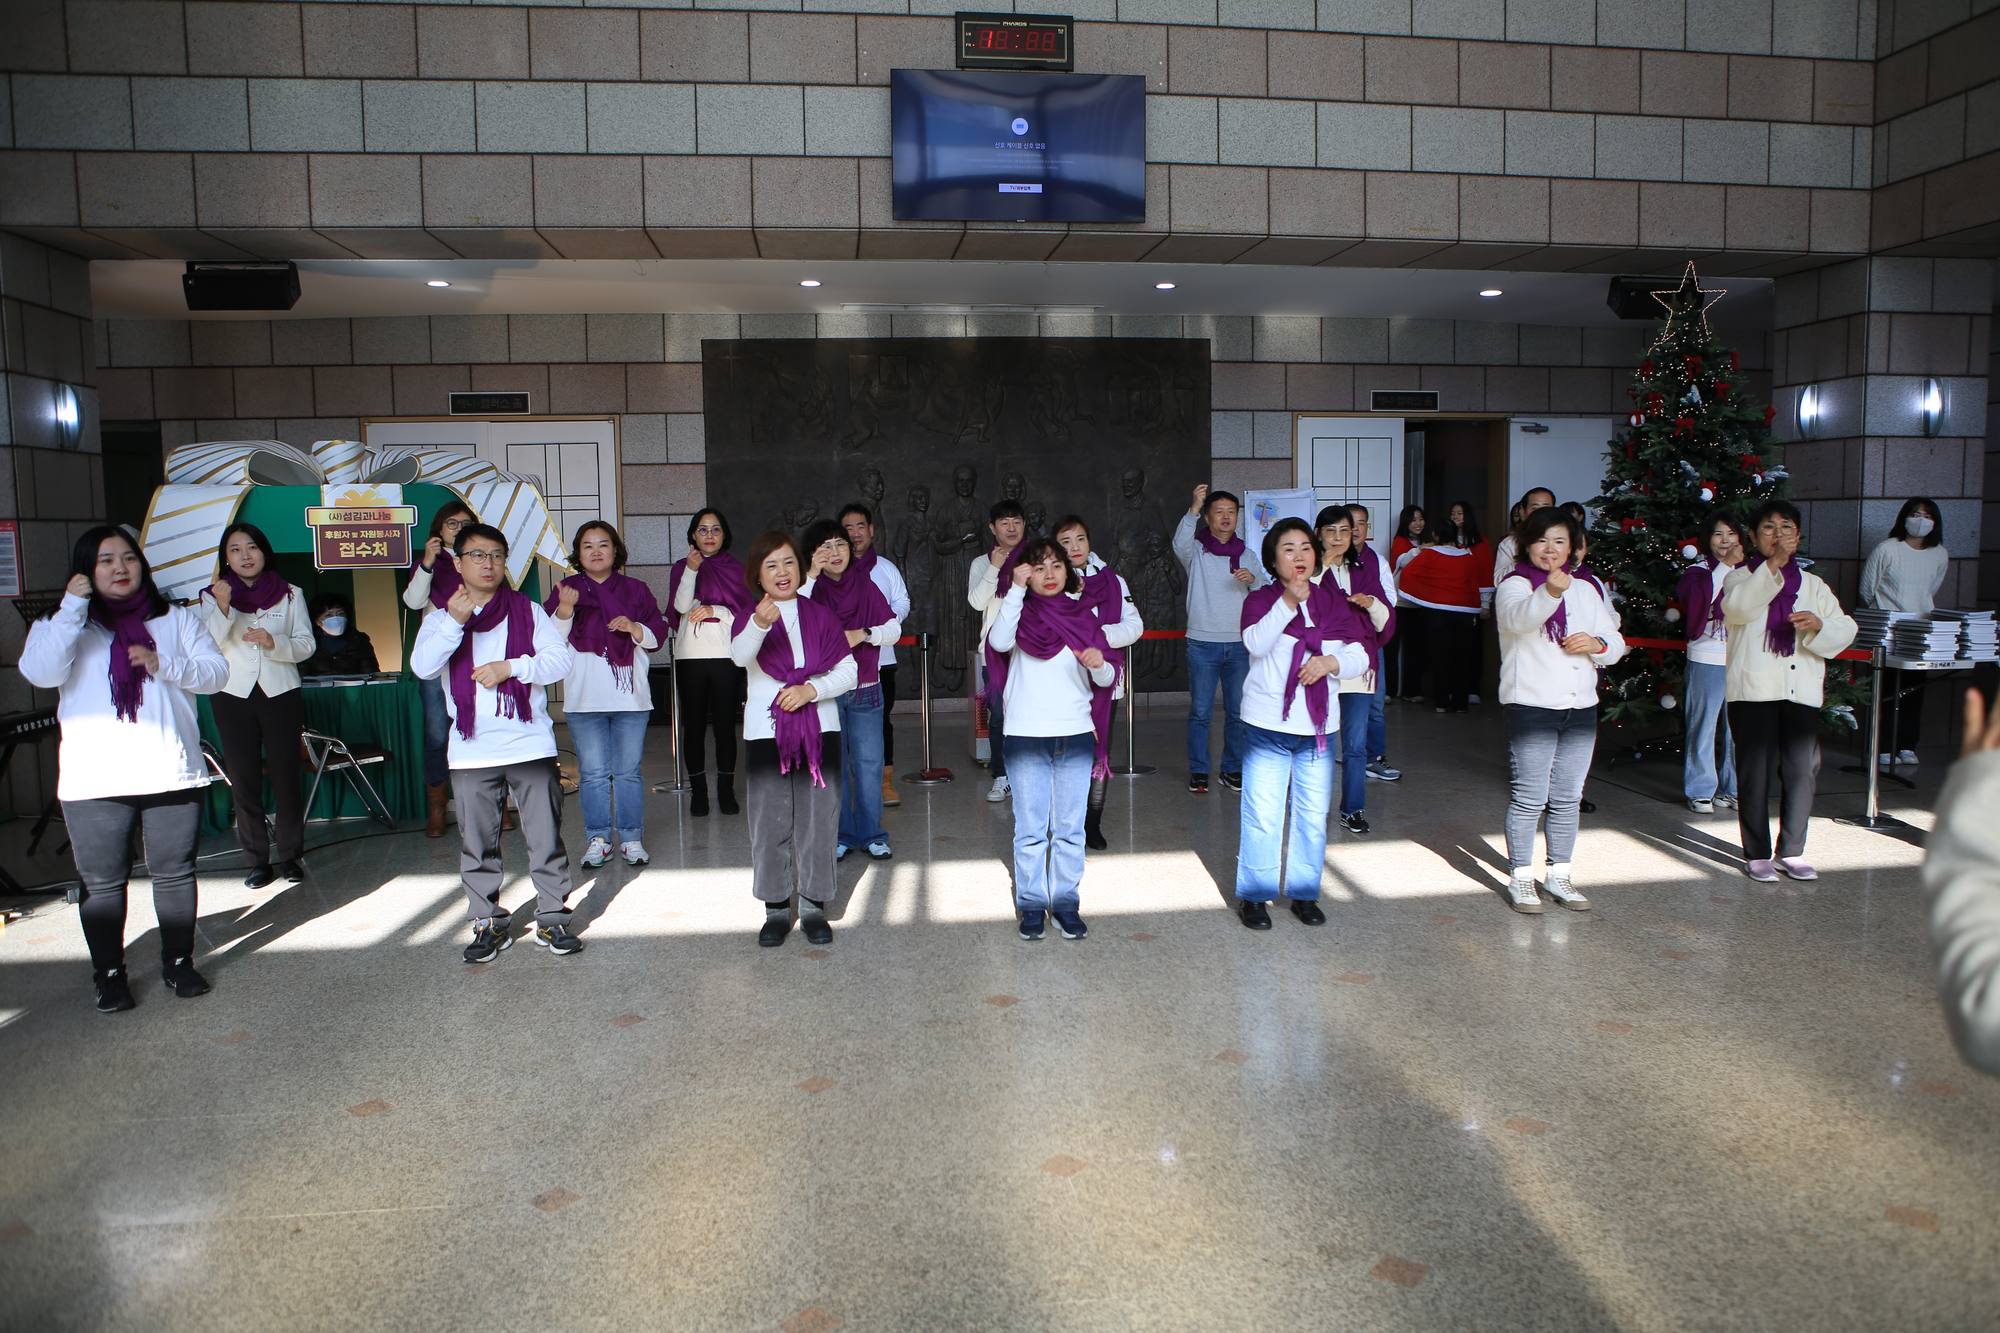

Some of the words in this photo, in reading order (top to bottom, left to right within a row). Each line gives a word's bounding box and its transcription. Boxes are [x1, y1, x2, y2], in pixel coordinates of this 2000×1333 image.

[325, 530, 350, 539] 후원자
[360, 530, 400, 539] 자원봉사자
[339, 541, 388, 558] 접수처
